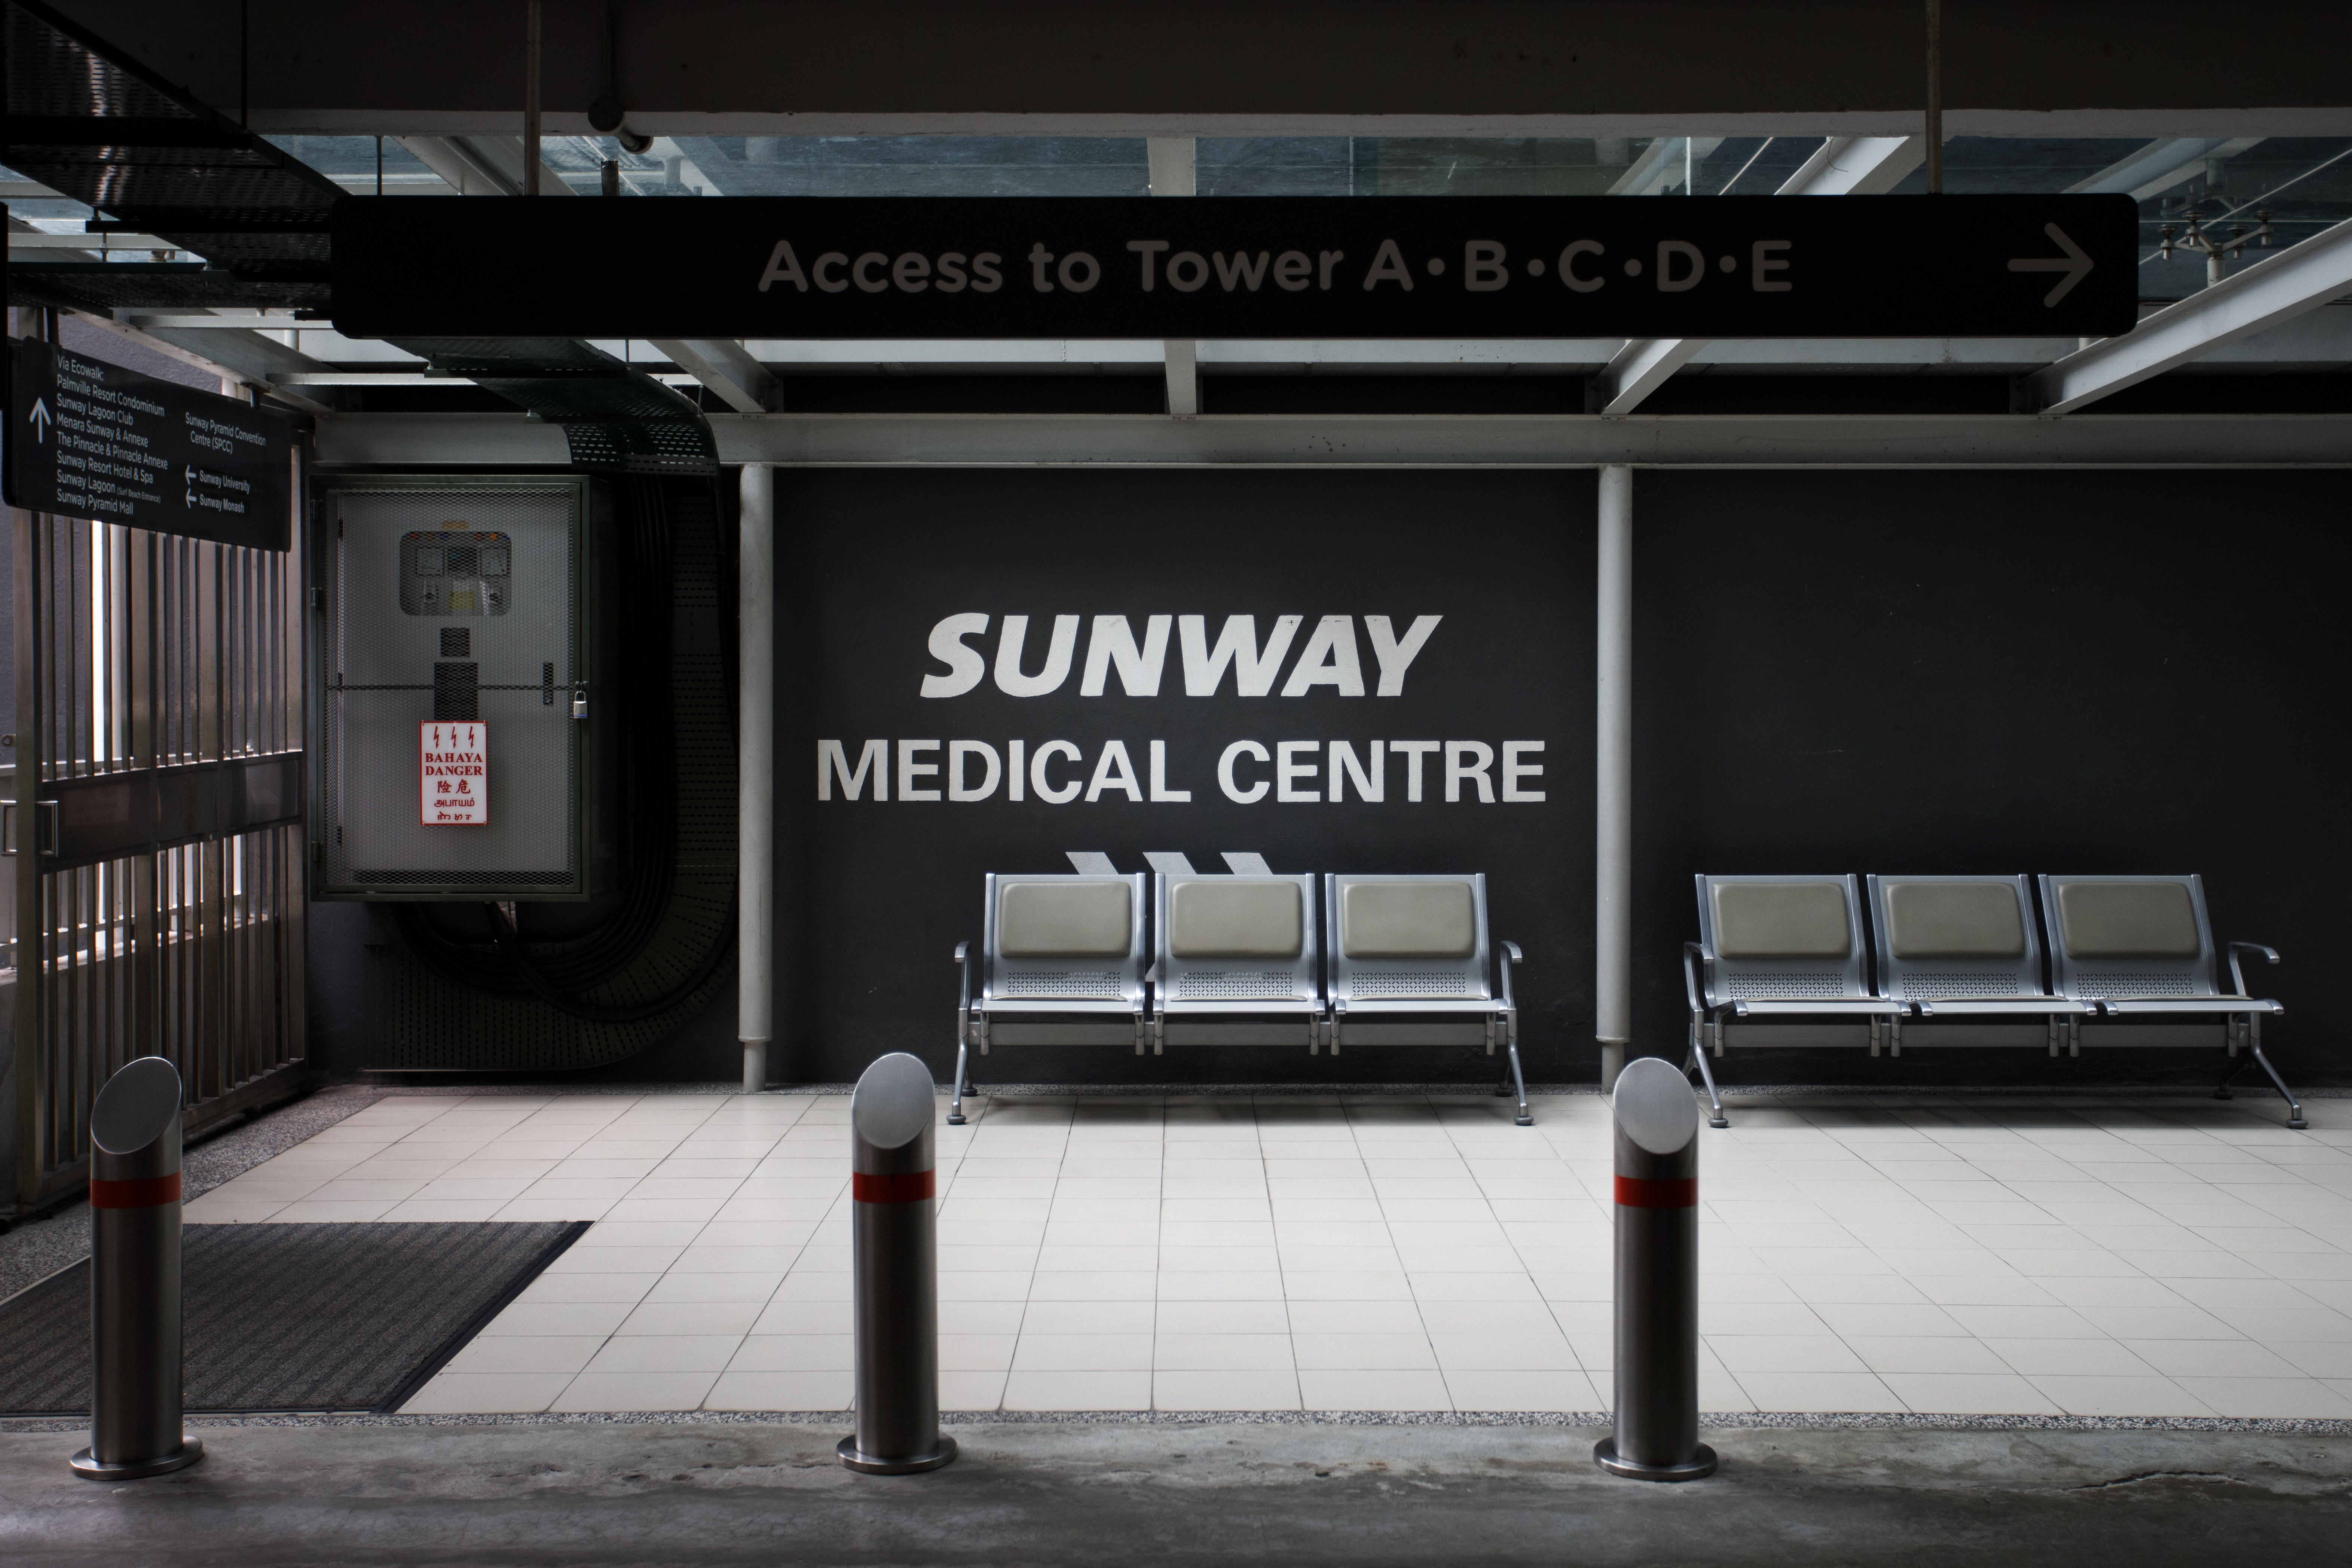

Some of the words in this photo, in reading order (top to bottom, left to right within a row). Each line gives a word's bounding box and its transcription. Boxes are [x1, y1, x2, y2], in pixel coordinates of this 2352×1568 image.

[758, 241, 1002, 293] Access
[1028, 243, 1100, 292] to
[1126, 241, 1343, 293] Tower
[57, 355, 69, 370] Via
[71, 359, 104, 381] Ecowalk:
[57, 374, 91, 396] Palmville
[93, 385, 116, 403] Resort
[118, 392, 165, 417] Condominium
[57, 393, 86, 415] Sunway
[89, 402, 116, 421] Lagoon
[117, 410, 133, 426] Club
[57, 412, 85, 431] Menara
[87, 420, 114, 441] Sunway
[116, 428, 121, 440] &
[123, 430, 148, 447] Annexe
[186, 412, 209, 432] Sunway
[211, 419, 234, 437] Pyramid
[235, 427, 266, 446] Convention
[190, 430, 211, 447] Centre
[212, 437, 233, 455] (SPCC)
[57, 431, 71, 447] The
[73, 435, 104, 455] Pinnacle
[106, 443, 111, 456] &
[113, 445, 141, 463] Pinnacle
[144, 452, 168, 470] Annexe
[57, 450, 86, 471] Sunway
[88, 457, 111, 475] Resort
[114, 464, 132, 479] Hotel
[134, 469, 138, 480] &
[141, 470, 153, 485] Spa
[57, 470, 86, 490] Sunway
[88, 476, 116, 493] Lagoon
[117, 487, 128, 495] (Surf
[129, 490, 141, 499] Beach
[142, 493, 161, 504] Entrance)
[200, 470, 222, 488] Sunway
[223, 475, 250, 495] University
[57, 489, 86, 509] Sunway
[88, 495, 118, 511] Pyramid
[120, 501, 133, 515] Mall
[200, 493, 222, 512] Sunway
[223, 498, 244, 513] Monash
[920, 612, 1443, 698] SUNWAY
[425, 753, 483, 762] BAHAYA
[425, 765, 483, 776] DANGER
[818, 739, 1192, 804] MEDICAL
[1217, 740, 1546, 804] CENTRE
